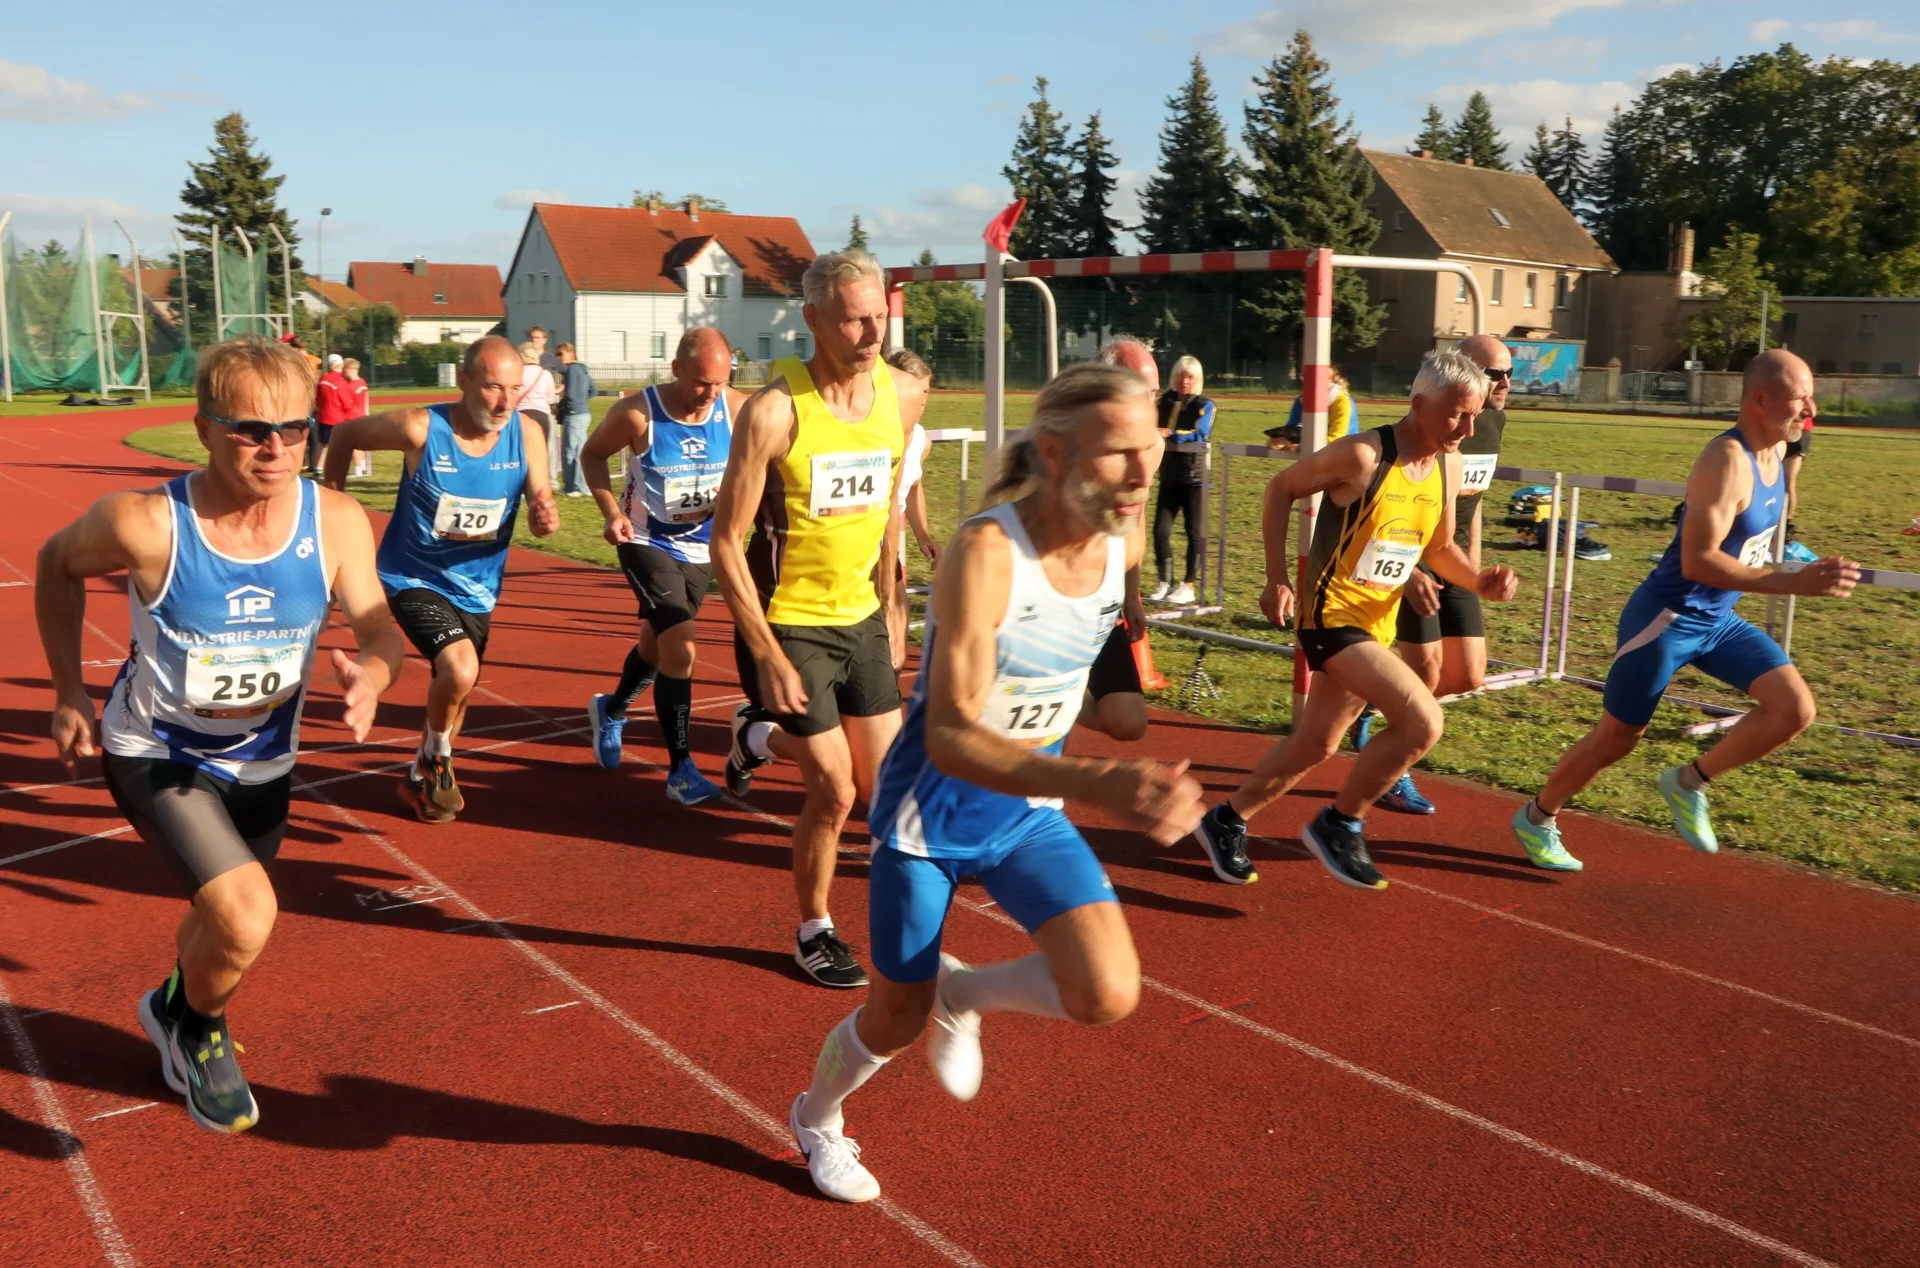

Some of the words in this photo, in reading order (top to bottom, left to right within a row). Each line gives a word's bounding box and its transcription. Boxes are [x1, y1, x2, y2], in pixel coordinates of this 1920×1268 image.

[830, 475, 875, 499] 214
[1463, 470, 1488, 485] 147
[680, 490, 711, 509] 251
[453, 512, 488, 529] 120
[1373, 559, 1405, 579] 163
[212, 671, 282, 701] 250
[672, 703, 690, 750] Kalenji
[1005, 701, 1064, 730] 127
